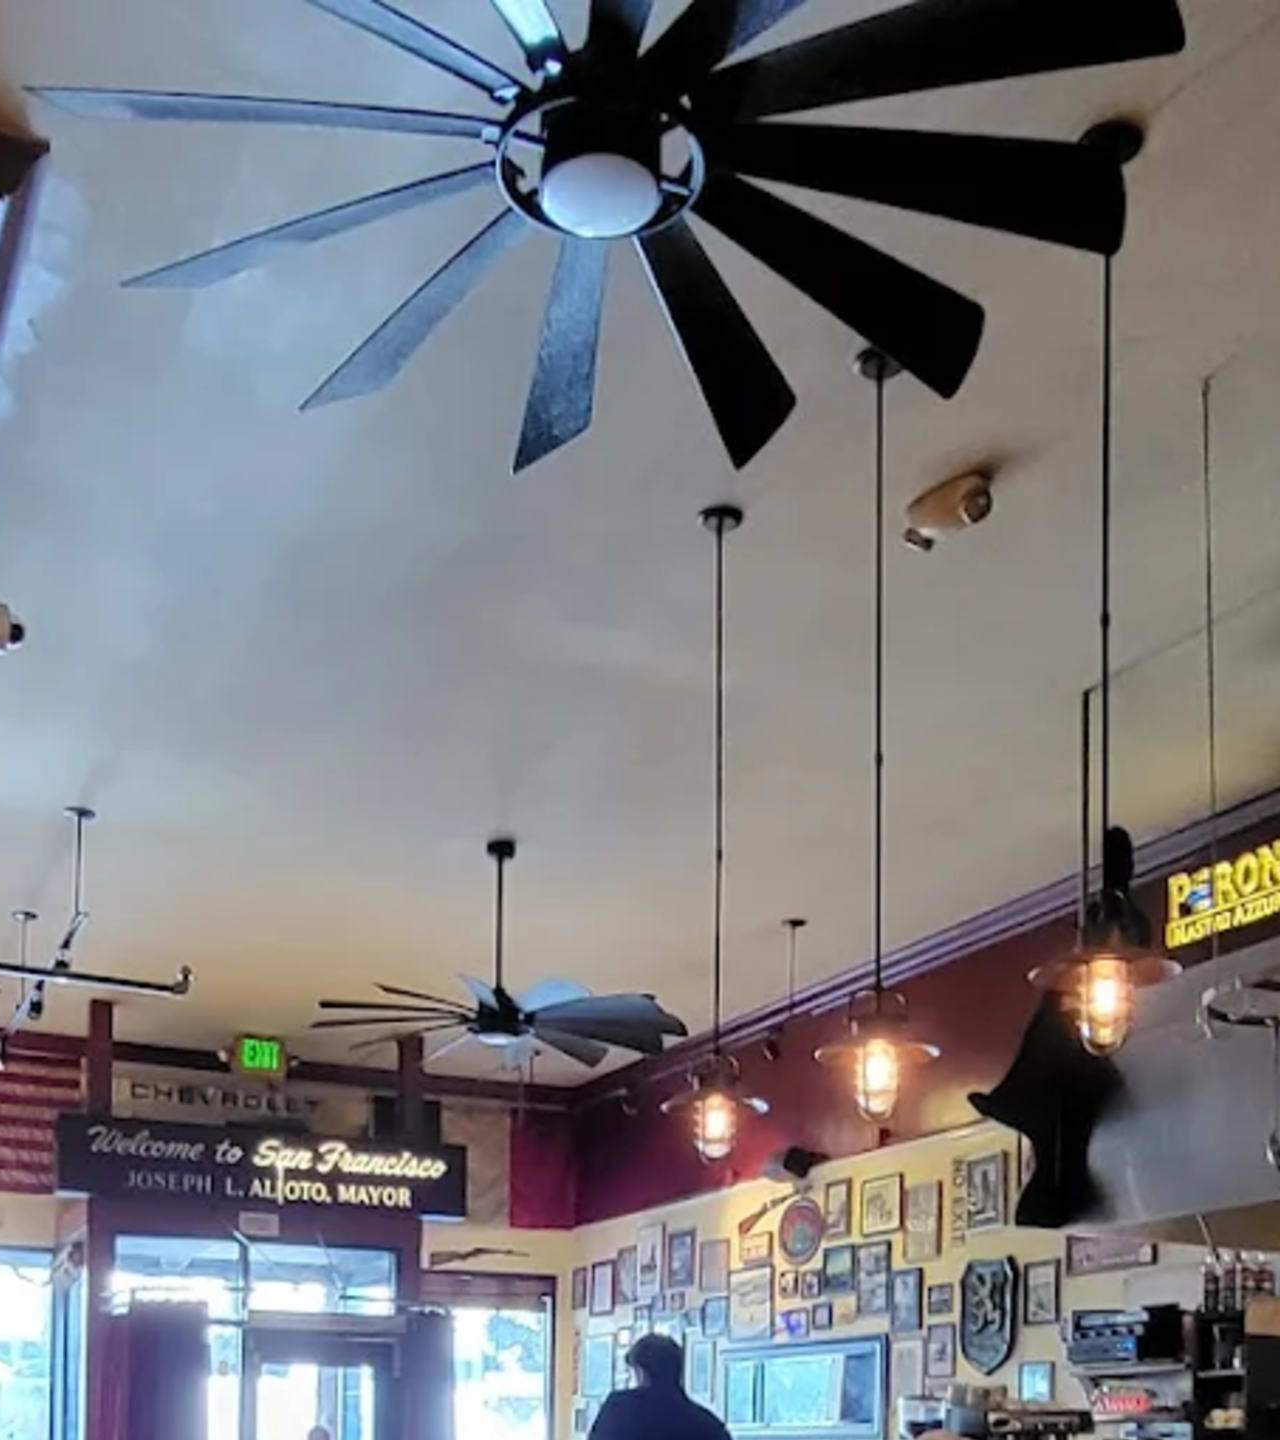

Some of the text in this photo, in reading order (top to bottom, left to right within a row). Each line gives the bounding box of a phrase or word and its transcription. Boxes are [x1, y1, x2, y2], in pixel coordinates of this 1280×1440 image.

[241, 1037, 280, 1070] EXIT
[87, 1125, 448, 1180] Welcome to San Francisco
[126, 1169, 213, 1194] JOSEPH
[225, 1177, 244, 1198] L.
[338, 1183, 412, 1208] MAYOR
[952, 1157, 966, 1246] NO EXIT
